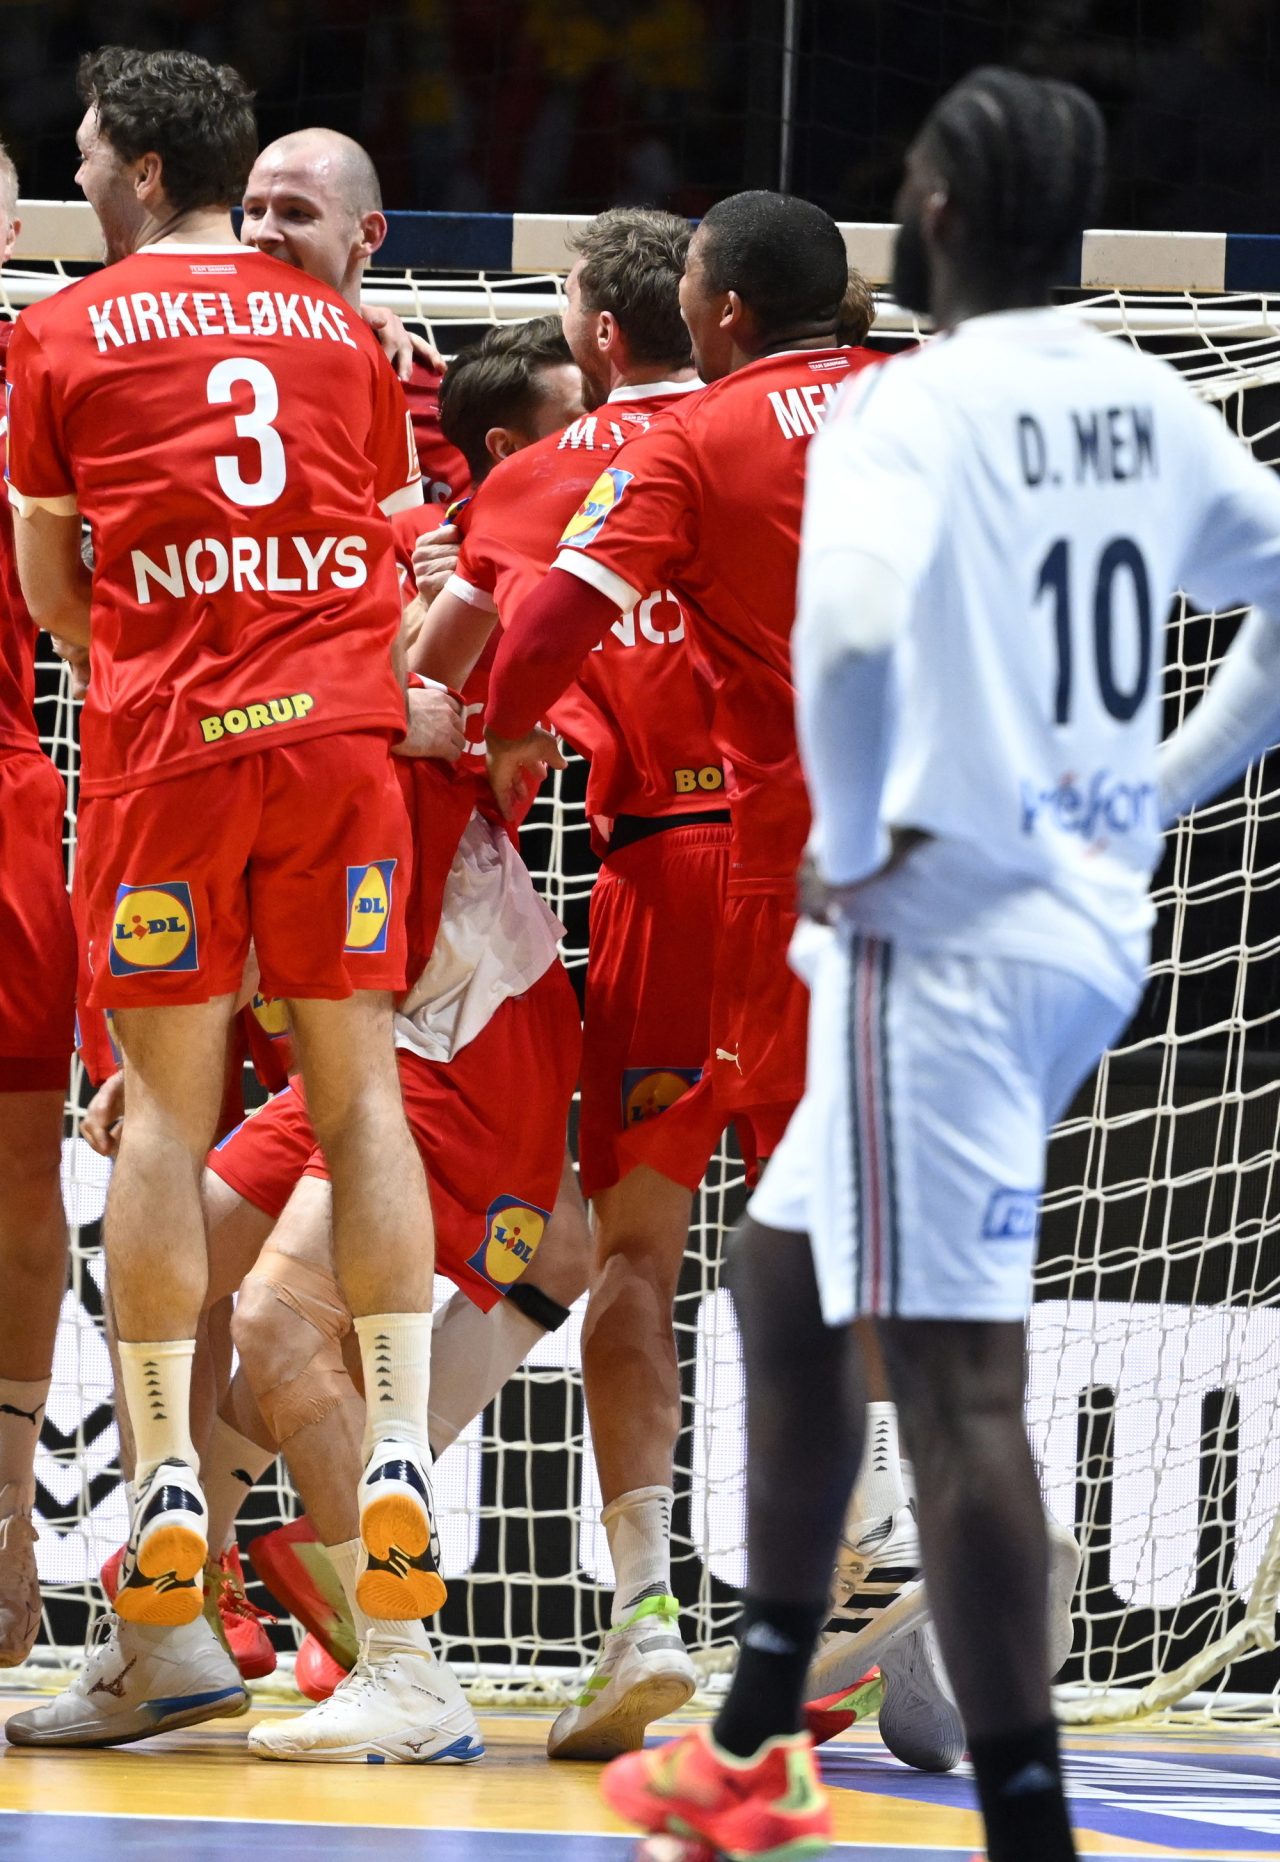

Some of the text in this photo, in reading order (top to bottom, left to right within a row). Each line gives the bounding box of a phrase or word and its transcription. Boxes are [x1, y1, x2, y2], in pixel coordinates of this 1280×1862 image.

[87, 292, 357, 355] KIRKELØKKE
[205, 358, 286, 507] 3
[131, 536, 367, 604] NORLYS
[1031, 537, 1151, 728] 10
[199, 693, 315, 743] BORUP
